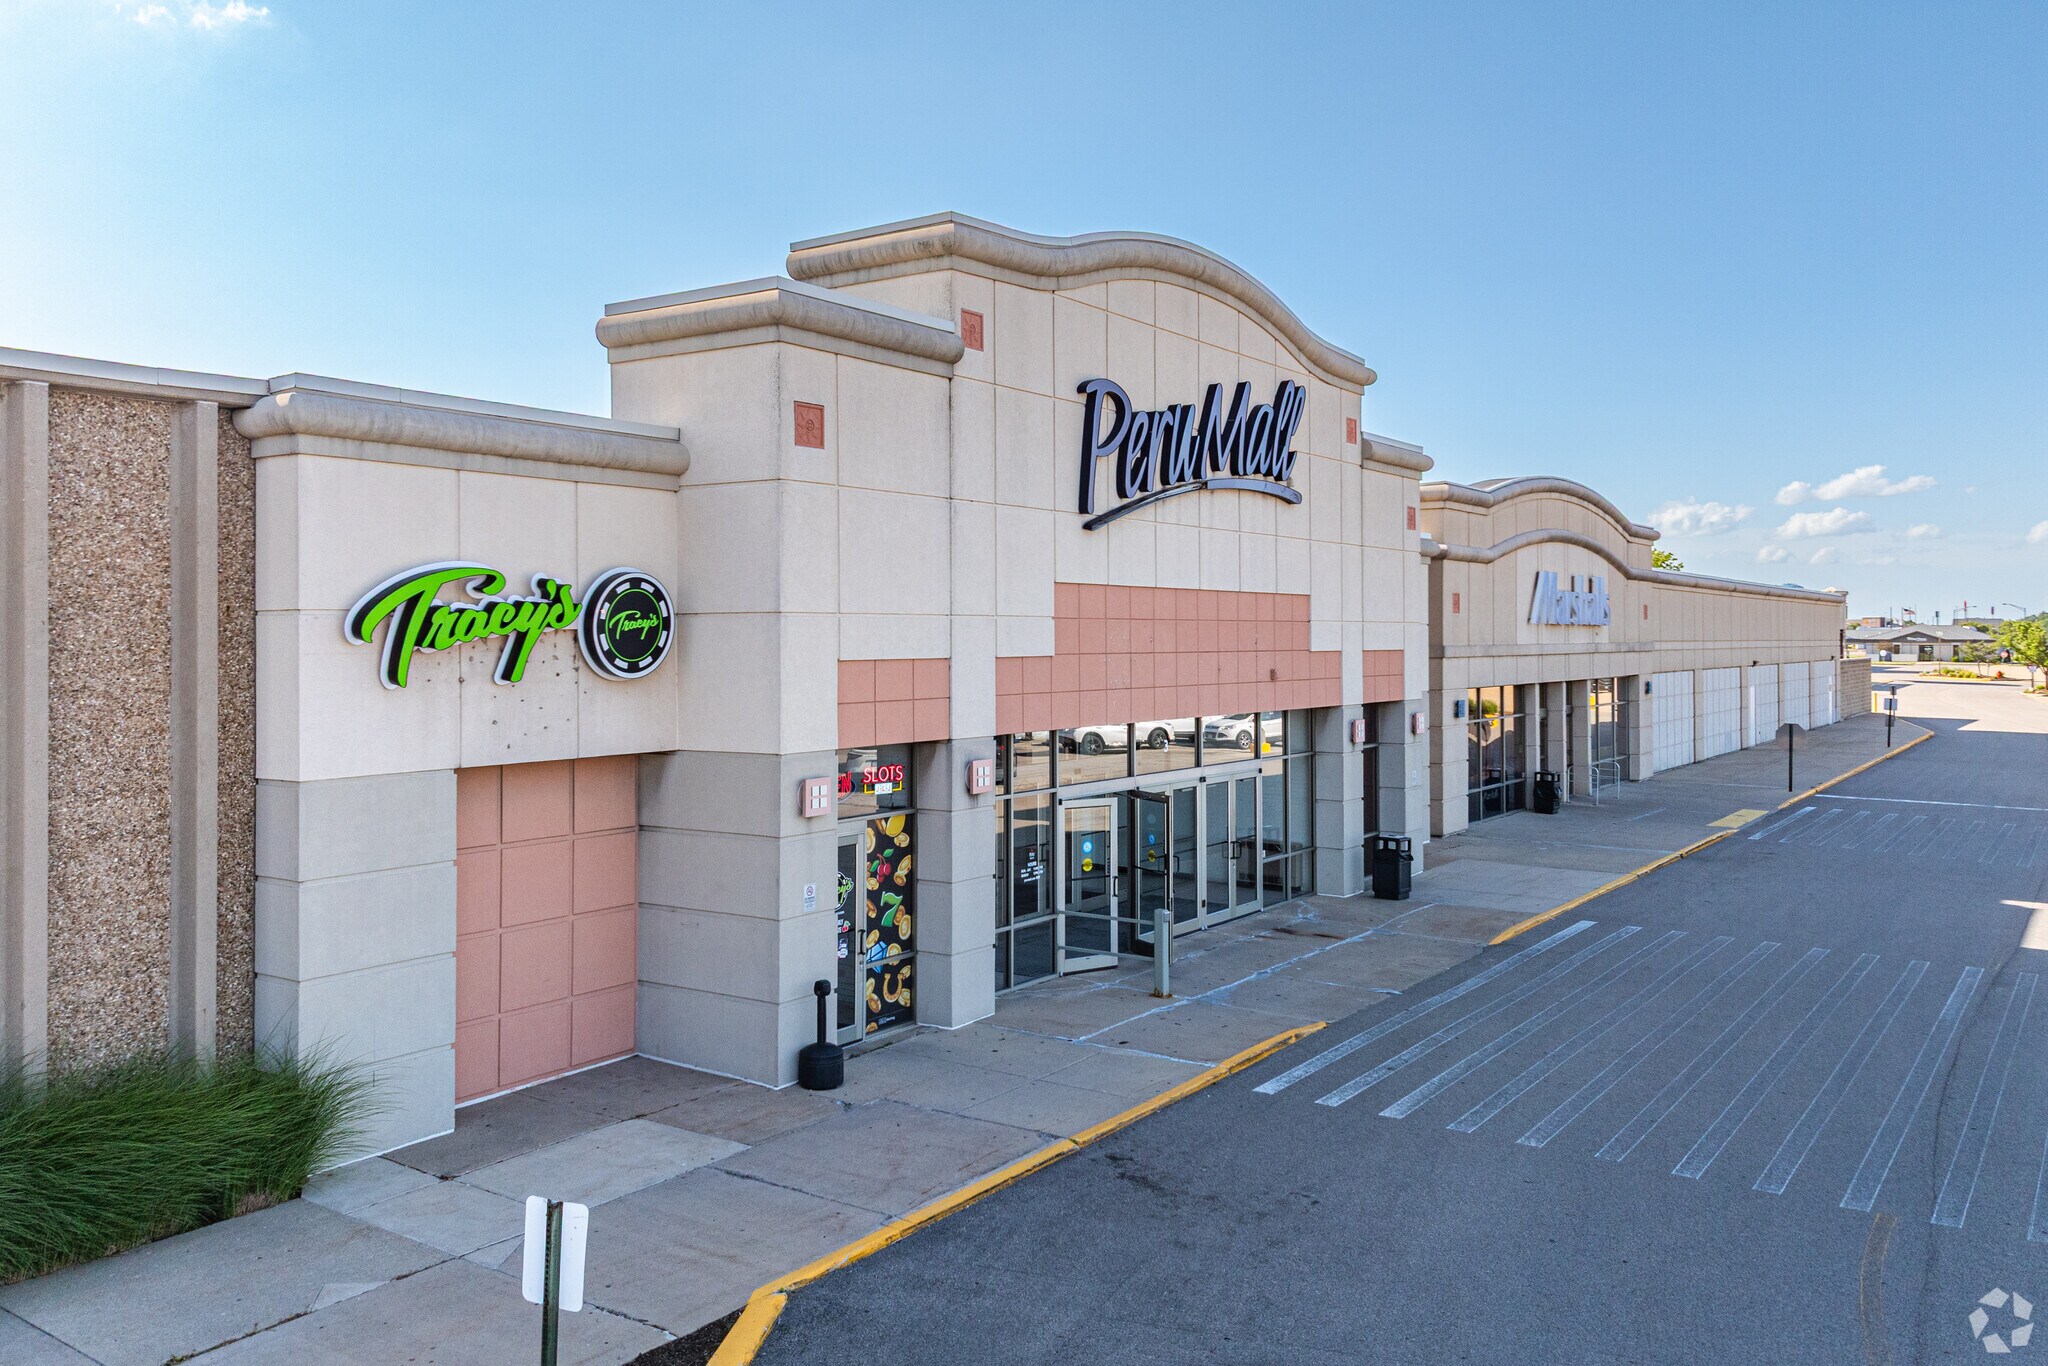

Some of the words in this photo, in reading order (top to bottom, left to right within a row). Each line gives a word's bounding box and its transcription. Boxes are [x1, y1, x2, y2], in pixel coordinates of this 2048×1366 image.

[1077, 378, 1201, 514] Peru
[1193, 379, 1306, 482] Mall
[352, 566, 583, 688] Tracy's
[862, 764, 905, 784] SLOTS
[880, 891, 903, 927] 7
